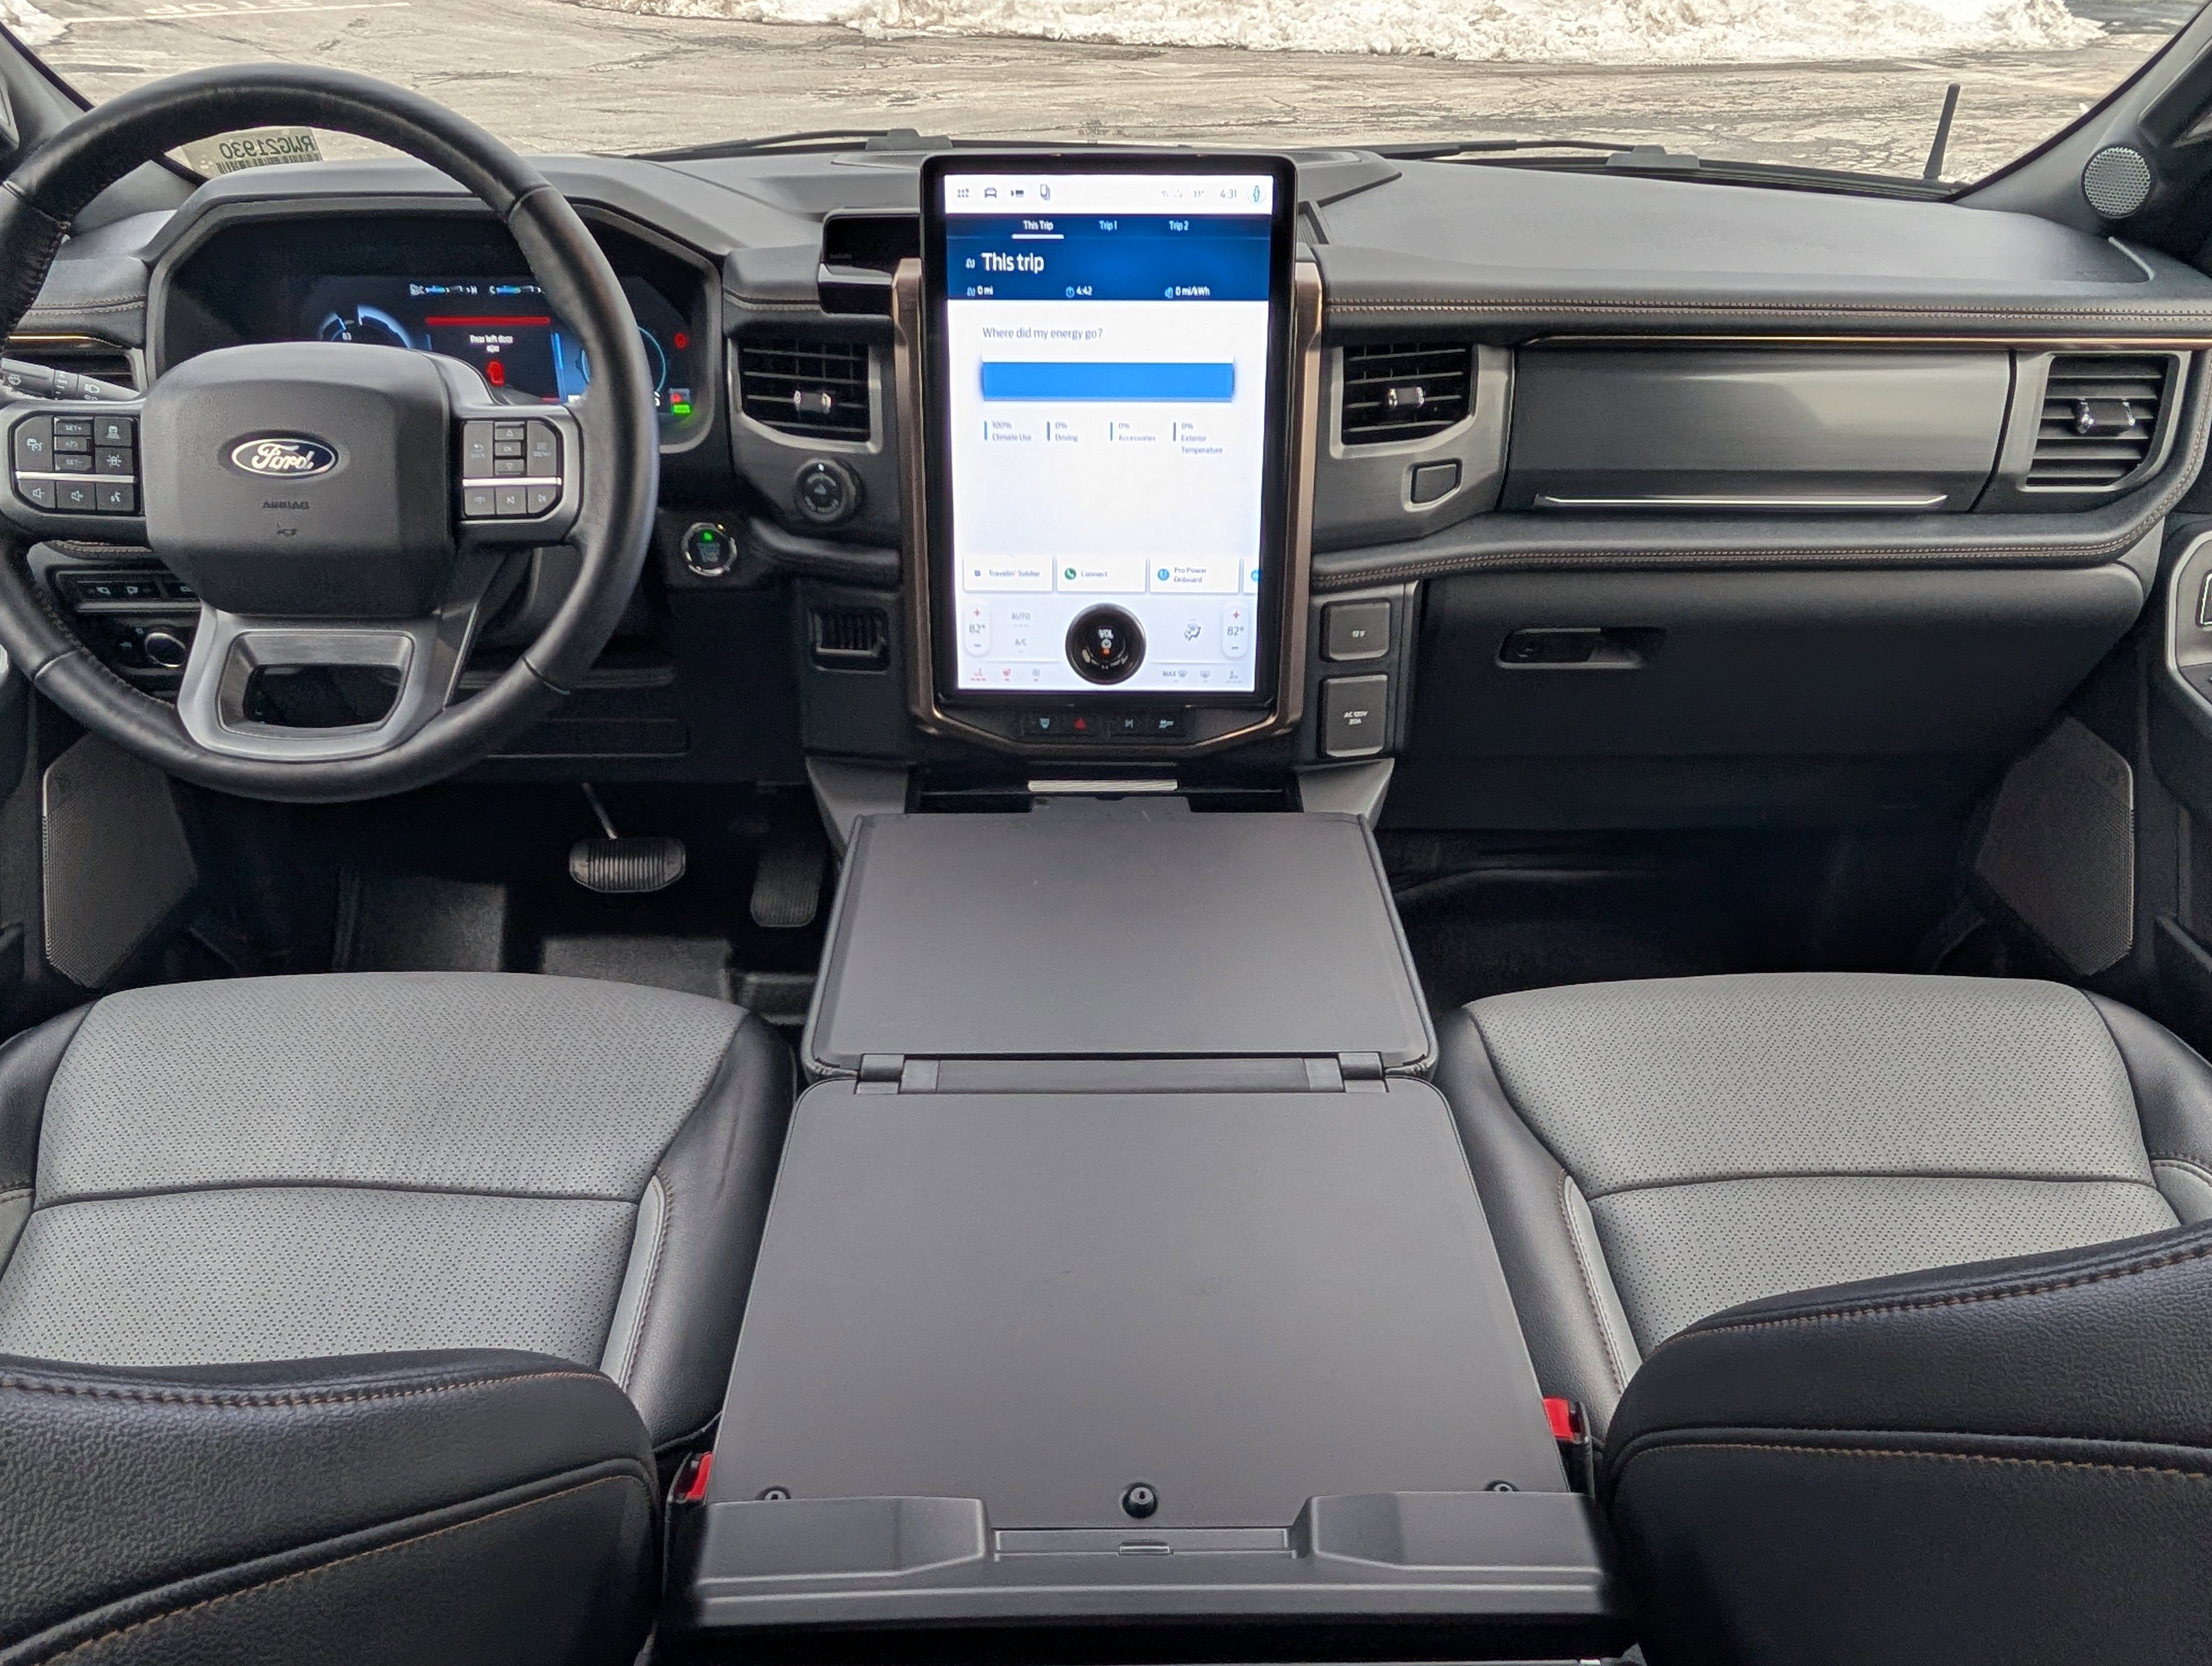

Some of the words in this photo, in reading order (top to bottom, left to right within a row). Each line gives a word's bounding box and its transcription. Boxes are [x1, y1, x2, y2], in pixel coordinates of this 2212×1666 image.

[144, 0, 313, 14] STOP
[1220, 189, 1237, 199] 4:31
[1023, 220, 1038, 230] This
[1039, 220, 1054, 232] Trip
[1099, 220, 1113, 232] Trip
[1114, 220, 1117, 230] 1
[1168, 220, 1183, 232] Trip
[1184, 220, 1189, 231] 2
[981, 252, 1015, 271] This
[1017, 252, 1044, 274] trip
[977, 285, 983, 296] 0
[983, 285, 994, 295] mi
[1175, 286, 1181, 296] 0
[982, 326, 1014, 339] Where
[1016, 327, 1031, 338] did
[1033, 329, 1049, 341] my
[1050, 329, 1083, 341] energy
[1085, 327, 1103, 341] go?
[251, 443, 316, 470] Ford
